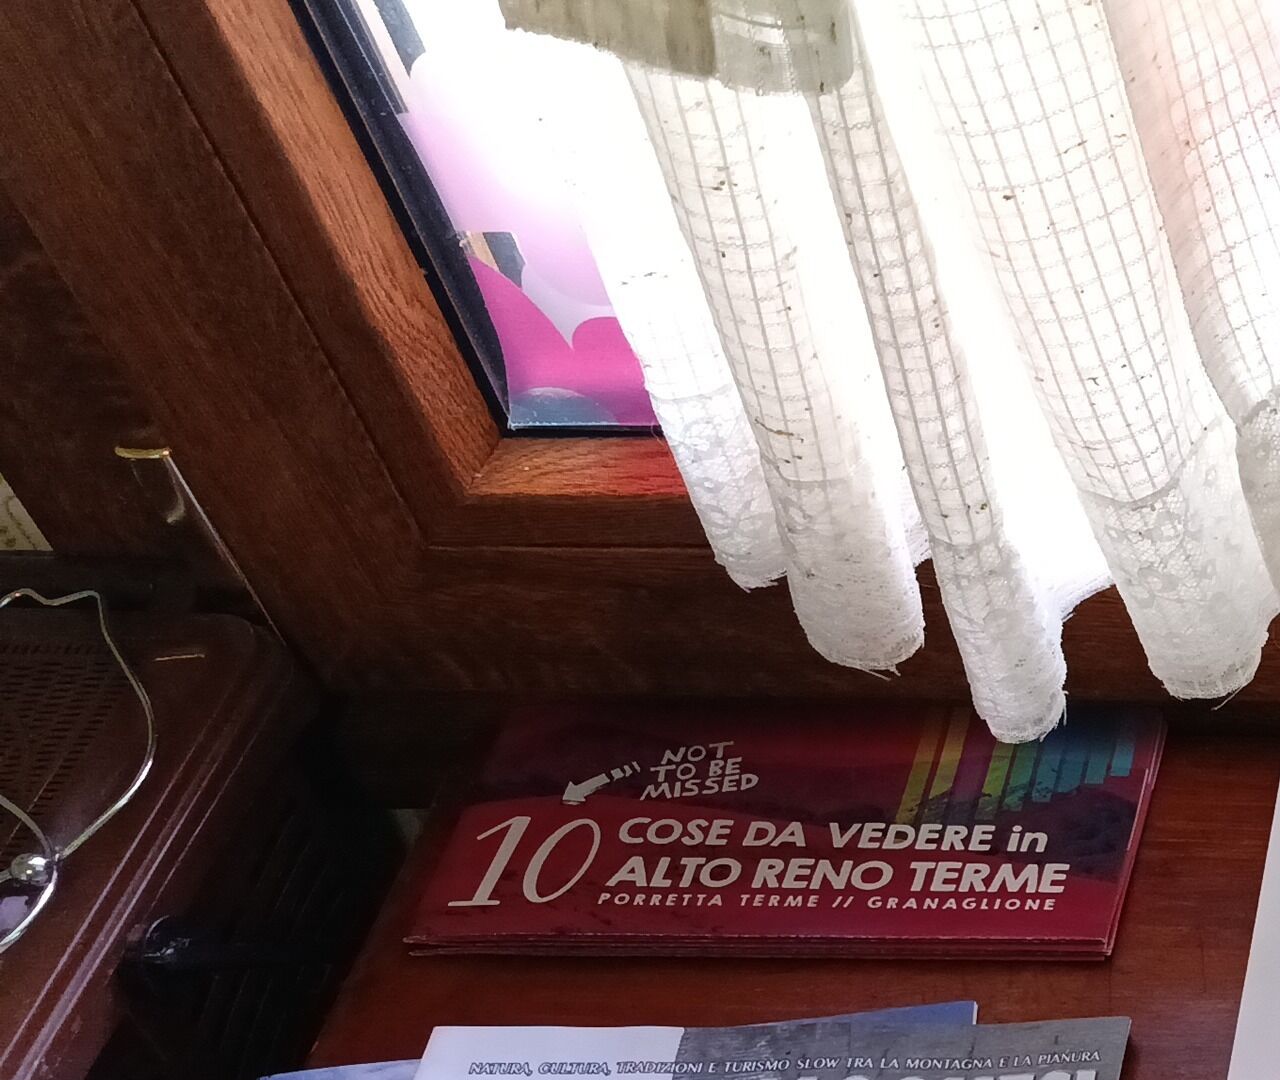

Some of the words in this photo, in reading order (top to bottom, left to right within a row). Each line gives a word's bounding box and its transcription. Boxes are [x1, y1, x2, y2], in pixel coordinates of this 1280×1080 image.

[662, 741, 734, 765] NOT
[650, 763, 695, 783] TO
[709, 757, 742, 777] BE
[639, 773, 759, 800] MISSED
[618, 817, 735, 847] COSE
[742, 821, 806, 847] DA
[828, 821, 996, 851] VEDERE
[1006, 825, 1049, 853] in
[448, 816, 601, 907] 10
[604, 856, 742, 889] ALTO
[751, 858, 894, 891] RENO
[910, 861, 1070, 893] TERME
[597, 893, 723, 907] PORRETTA
[740, 894, 820, 908] TERME
[867, 896, 1056, 911] GRANAGLIONE
[615, 1061, 703, 1075] TRADIZIONI
[707, 1061, 717, 1073] E
[723, 1058, 790, 1073] TURISMO
[796, 1056, 840, 1070] SLOW
[846, 1056, 873, 1070] TRA
[879, 1056, 900, 1069] LA
[905, 1055, 994, 1070] MONTAGNA
[999, 1055, 1009, 1067] E
[1013, 1054, 1032, 1068] LA
[1037, 1050, 1102, 1067] PIANURA
